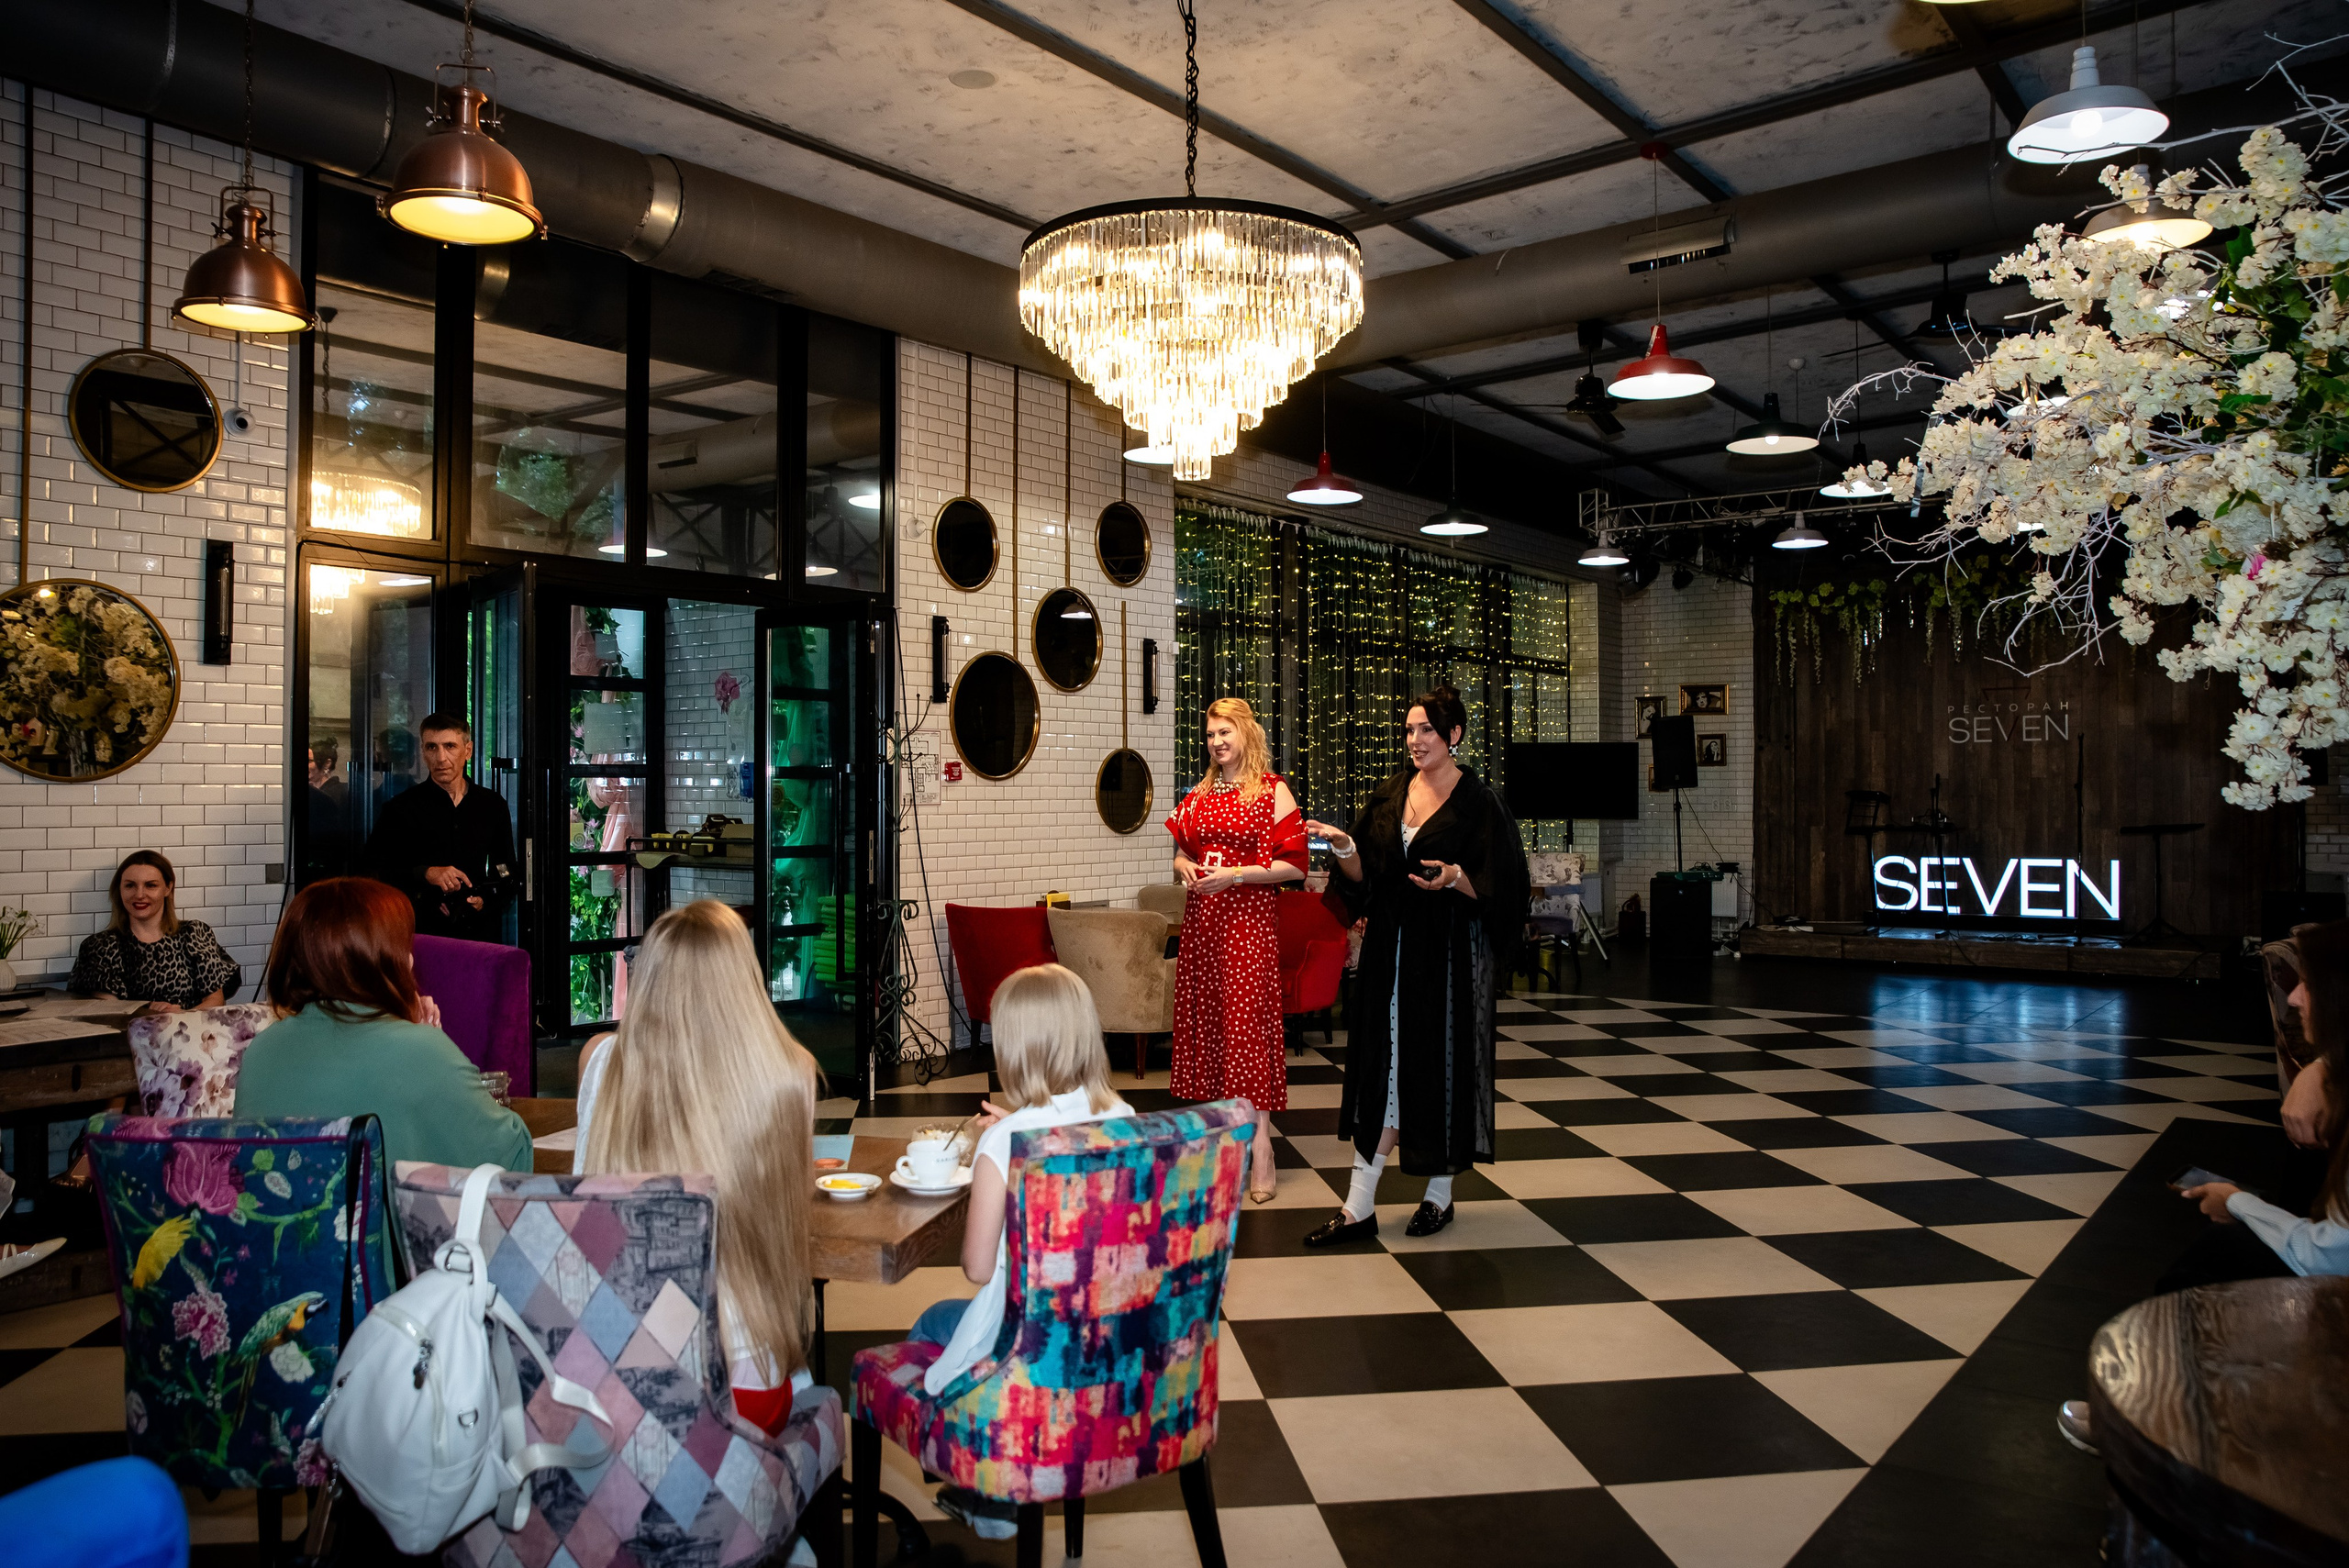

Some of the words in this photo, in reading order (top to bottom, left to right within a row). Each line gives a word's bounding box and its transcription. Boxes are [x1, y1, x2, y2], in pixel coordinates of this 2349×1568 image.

[1947, 701, 2069, 714] РЕСТОРАН
[1948, 714, 2069, 743] SEVEN
[1874, 855, 2120, 920] SEVEN
